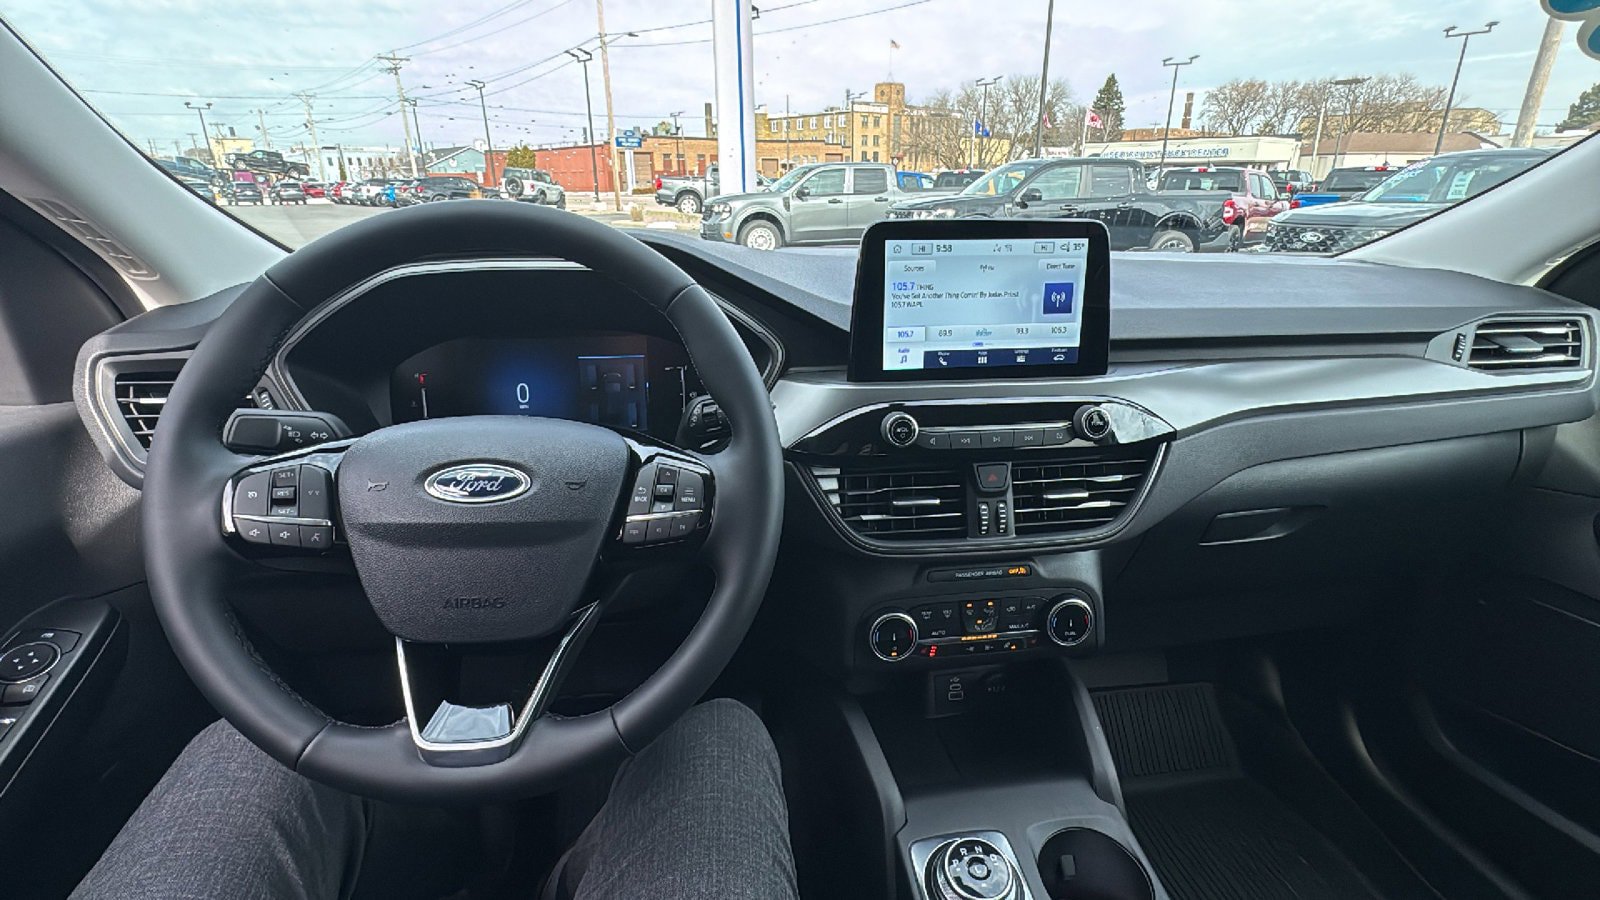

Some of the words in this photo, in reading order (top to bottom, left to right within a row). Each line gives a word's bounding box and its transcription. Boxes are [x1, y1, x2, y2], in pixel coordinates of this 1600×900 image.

[892, 282, 915, 290] 105.7
[897, 330, 914, 339] 105.7
[516, 382, 530, 404] 0
[961, 848, 968, 856] R
[974, 845, 983, 854] N
